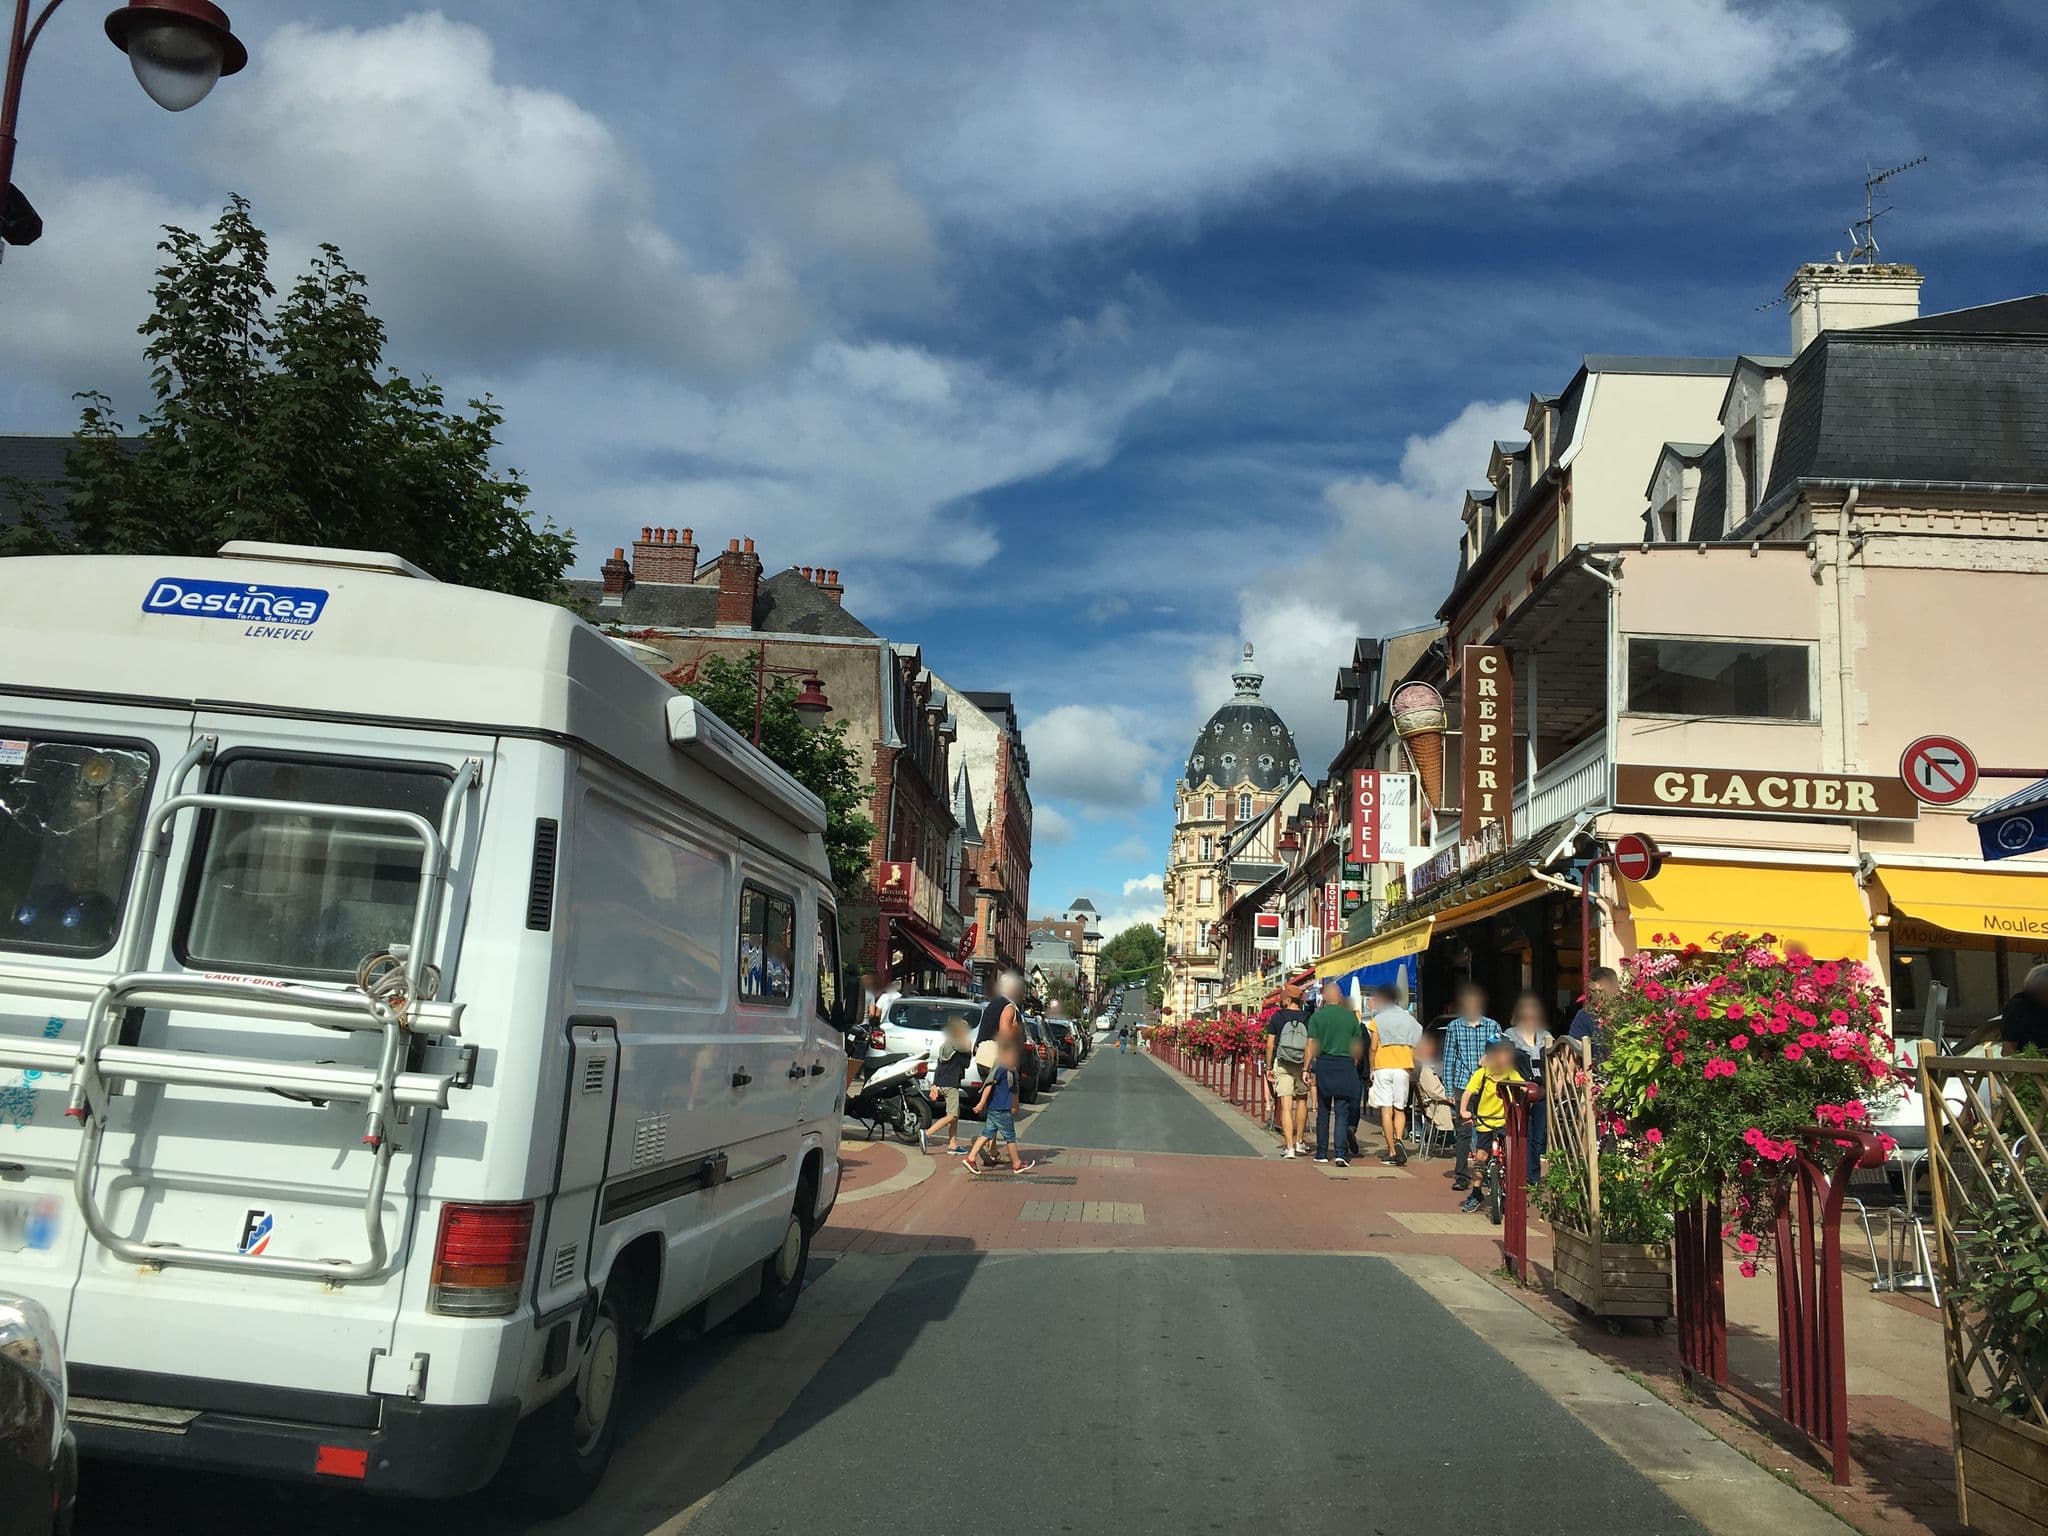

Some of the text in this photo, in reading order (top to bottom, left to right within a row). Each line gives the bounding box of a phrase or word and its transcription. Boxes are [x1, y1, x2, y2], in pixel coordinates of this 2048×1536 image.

[237, 613, 261, 621] Terre
[281, 616, 310, 624] loisirs
[245, 626, 314, 641] LENEVEU
[1382, 789, 1406, 807] Villa
[1653, 771, 1879, 812] GLACIER
[1360, 774, 1374, 858] HOTEL
[1984, 914, 2048, 933] Moules
[960, 932, 975, 956] TABAC
[240, 1209, 265, 1249] F
